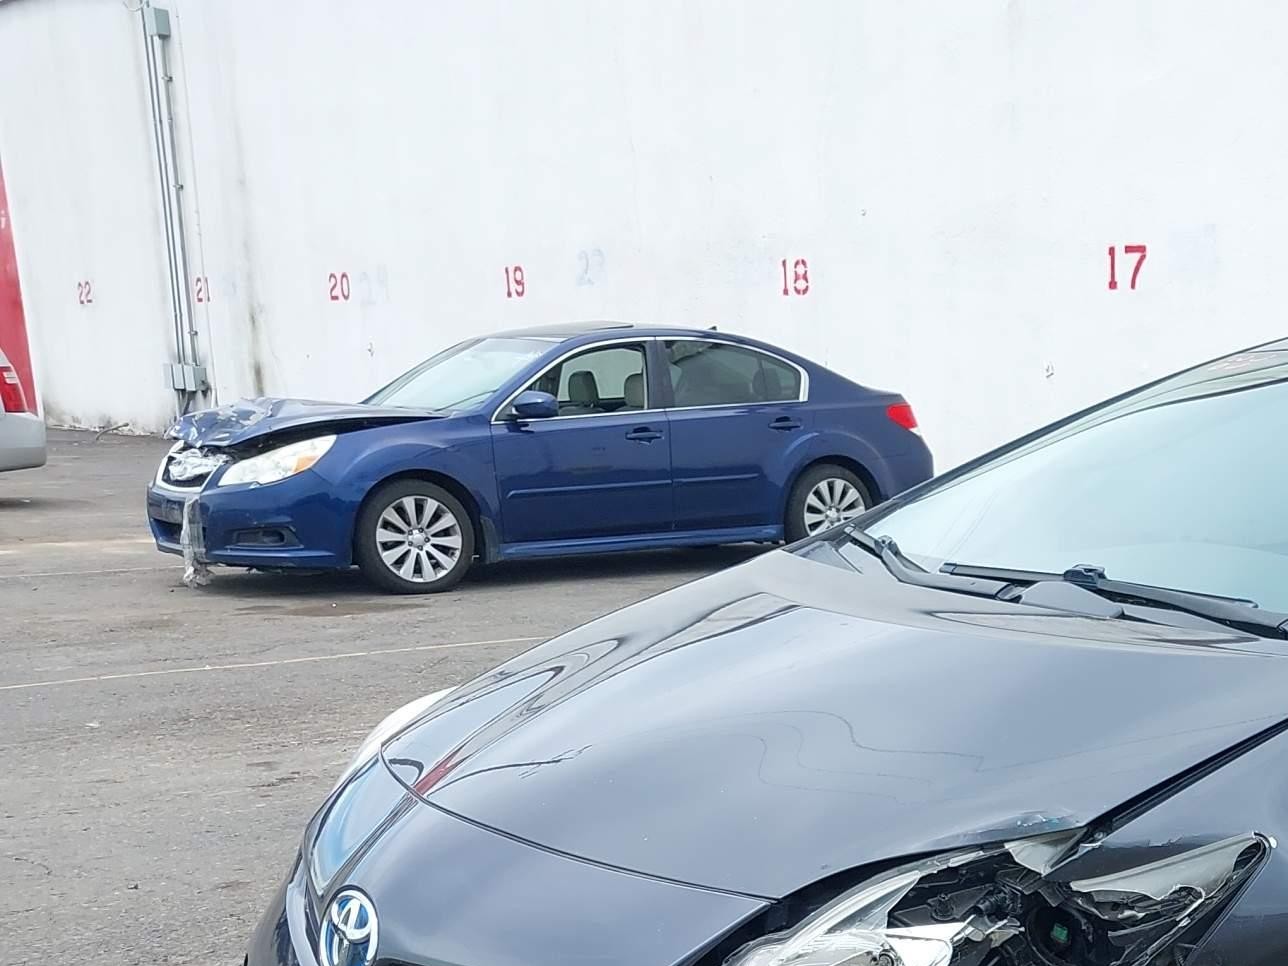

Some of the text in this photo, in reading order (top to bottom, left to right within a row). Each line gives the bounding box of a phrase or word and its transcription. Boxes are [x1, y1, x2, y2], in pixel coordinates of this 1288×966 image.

[505, 265, 525, 299] 19
[782, 258, 809, 296] 18
[1108, 245, 1146, 290] 17
[78, 281, 93, 305] 22
[195, 276, 211, 303] 21
[328, 272, 351, 301] 20
